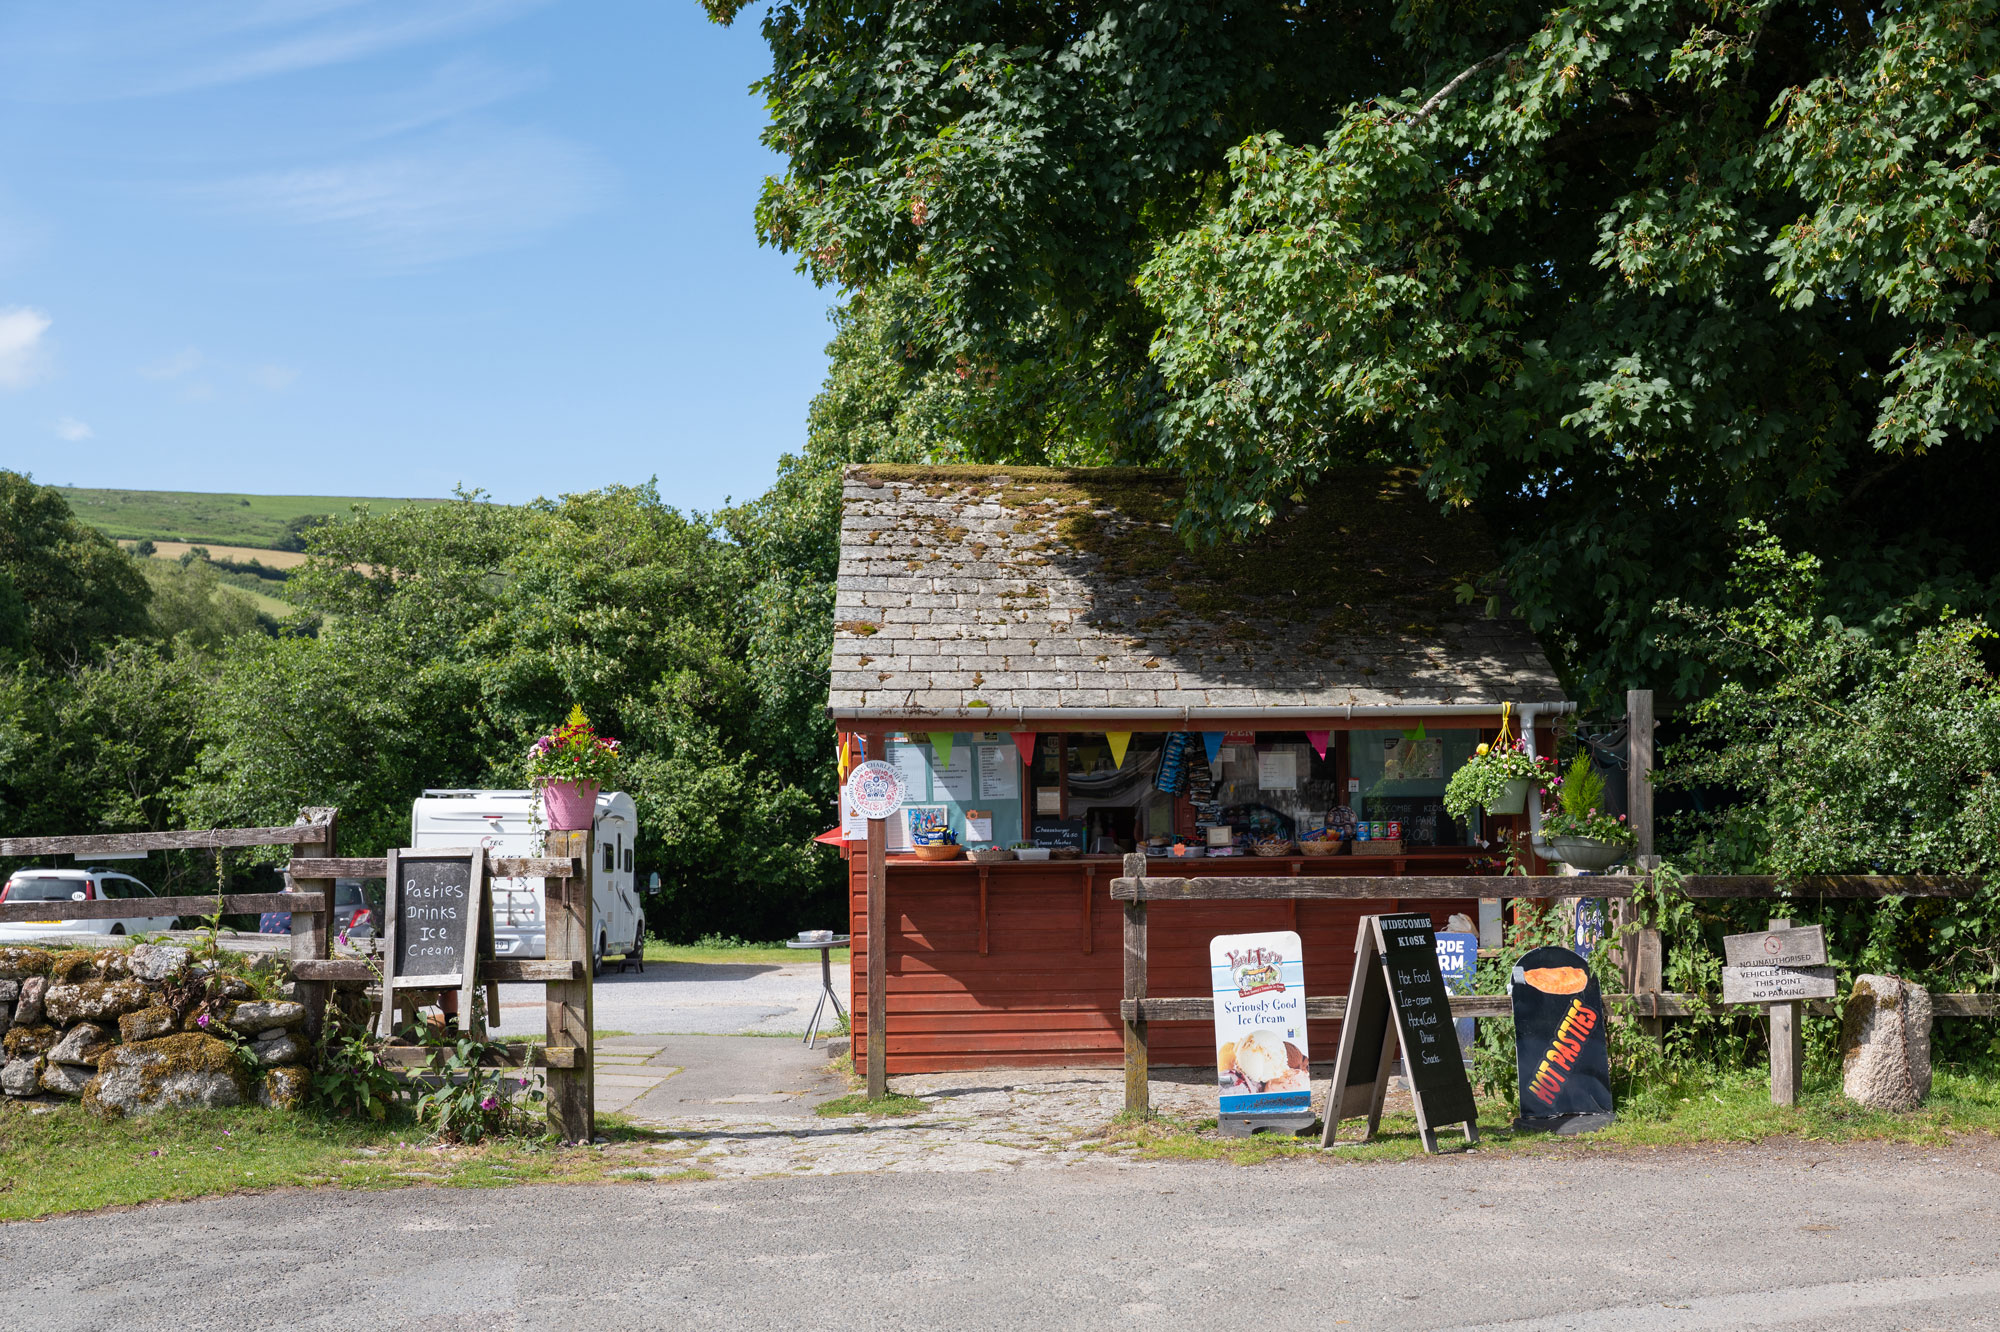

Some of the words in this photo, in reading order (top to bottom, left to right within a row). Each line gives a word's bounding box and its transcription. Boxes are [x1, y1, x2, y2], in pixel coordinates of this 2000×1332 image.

[866, 762, 894, 774] CHARLES
[406, 879, 464, 899] Pasties
[407, 904, 457, 920] Drinks
[1380, 918, 1432, 931] WIDECOMBE
[420, 927, 447, 941] Ice
[1397, 935, 1427, 947] KIOSK
[407, 944, 454, 957] Cream
[1752, 954, 1812, 968] UNAUTHORISED
[1397, 969, 1412, 985] Hot
[1412, 968, 1431, 984] Food
[1740, 970, 1780, 979] VEHICLES
[1781, 967, 1816, 976] BEYOND
[1755, 979, 1775, 987] THIS
[1775, 977, 1802, 986] POINT
[1397, 989, 1433, 1008] Ice-cream
[1768, 988, 1806, 998] PARKING
[1224, 1000, 1270, 1014] Seriously
[1272, 998, 1297, 1011] Good
[1238, 1014, 1252, 1025] Ice
[1254, 1013, 1286, 1025] Cream
[1546, 998, 1597, 1072] PASTIES
[1528, 1060, 1566, 1105] HOT
